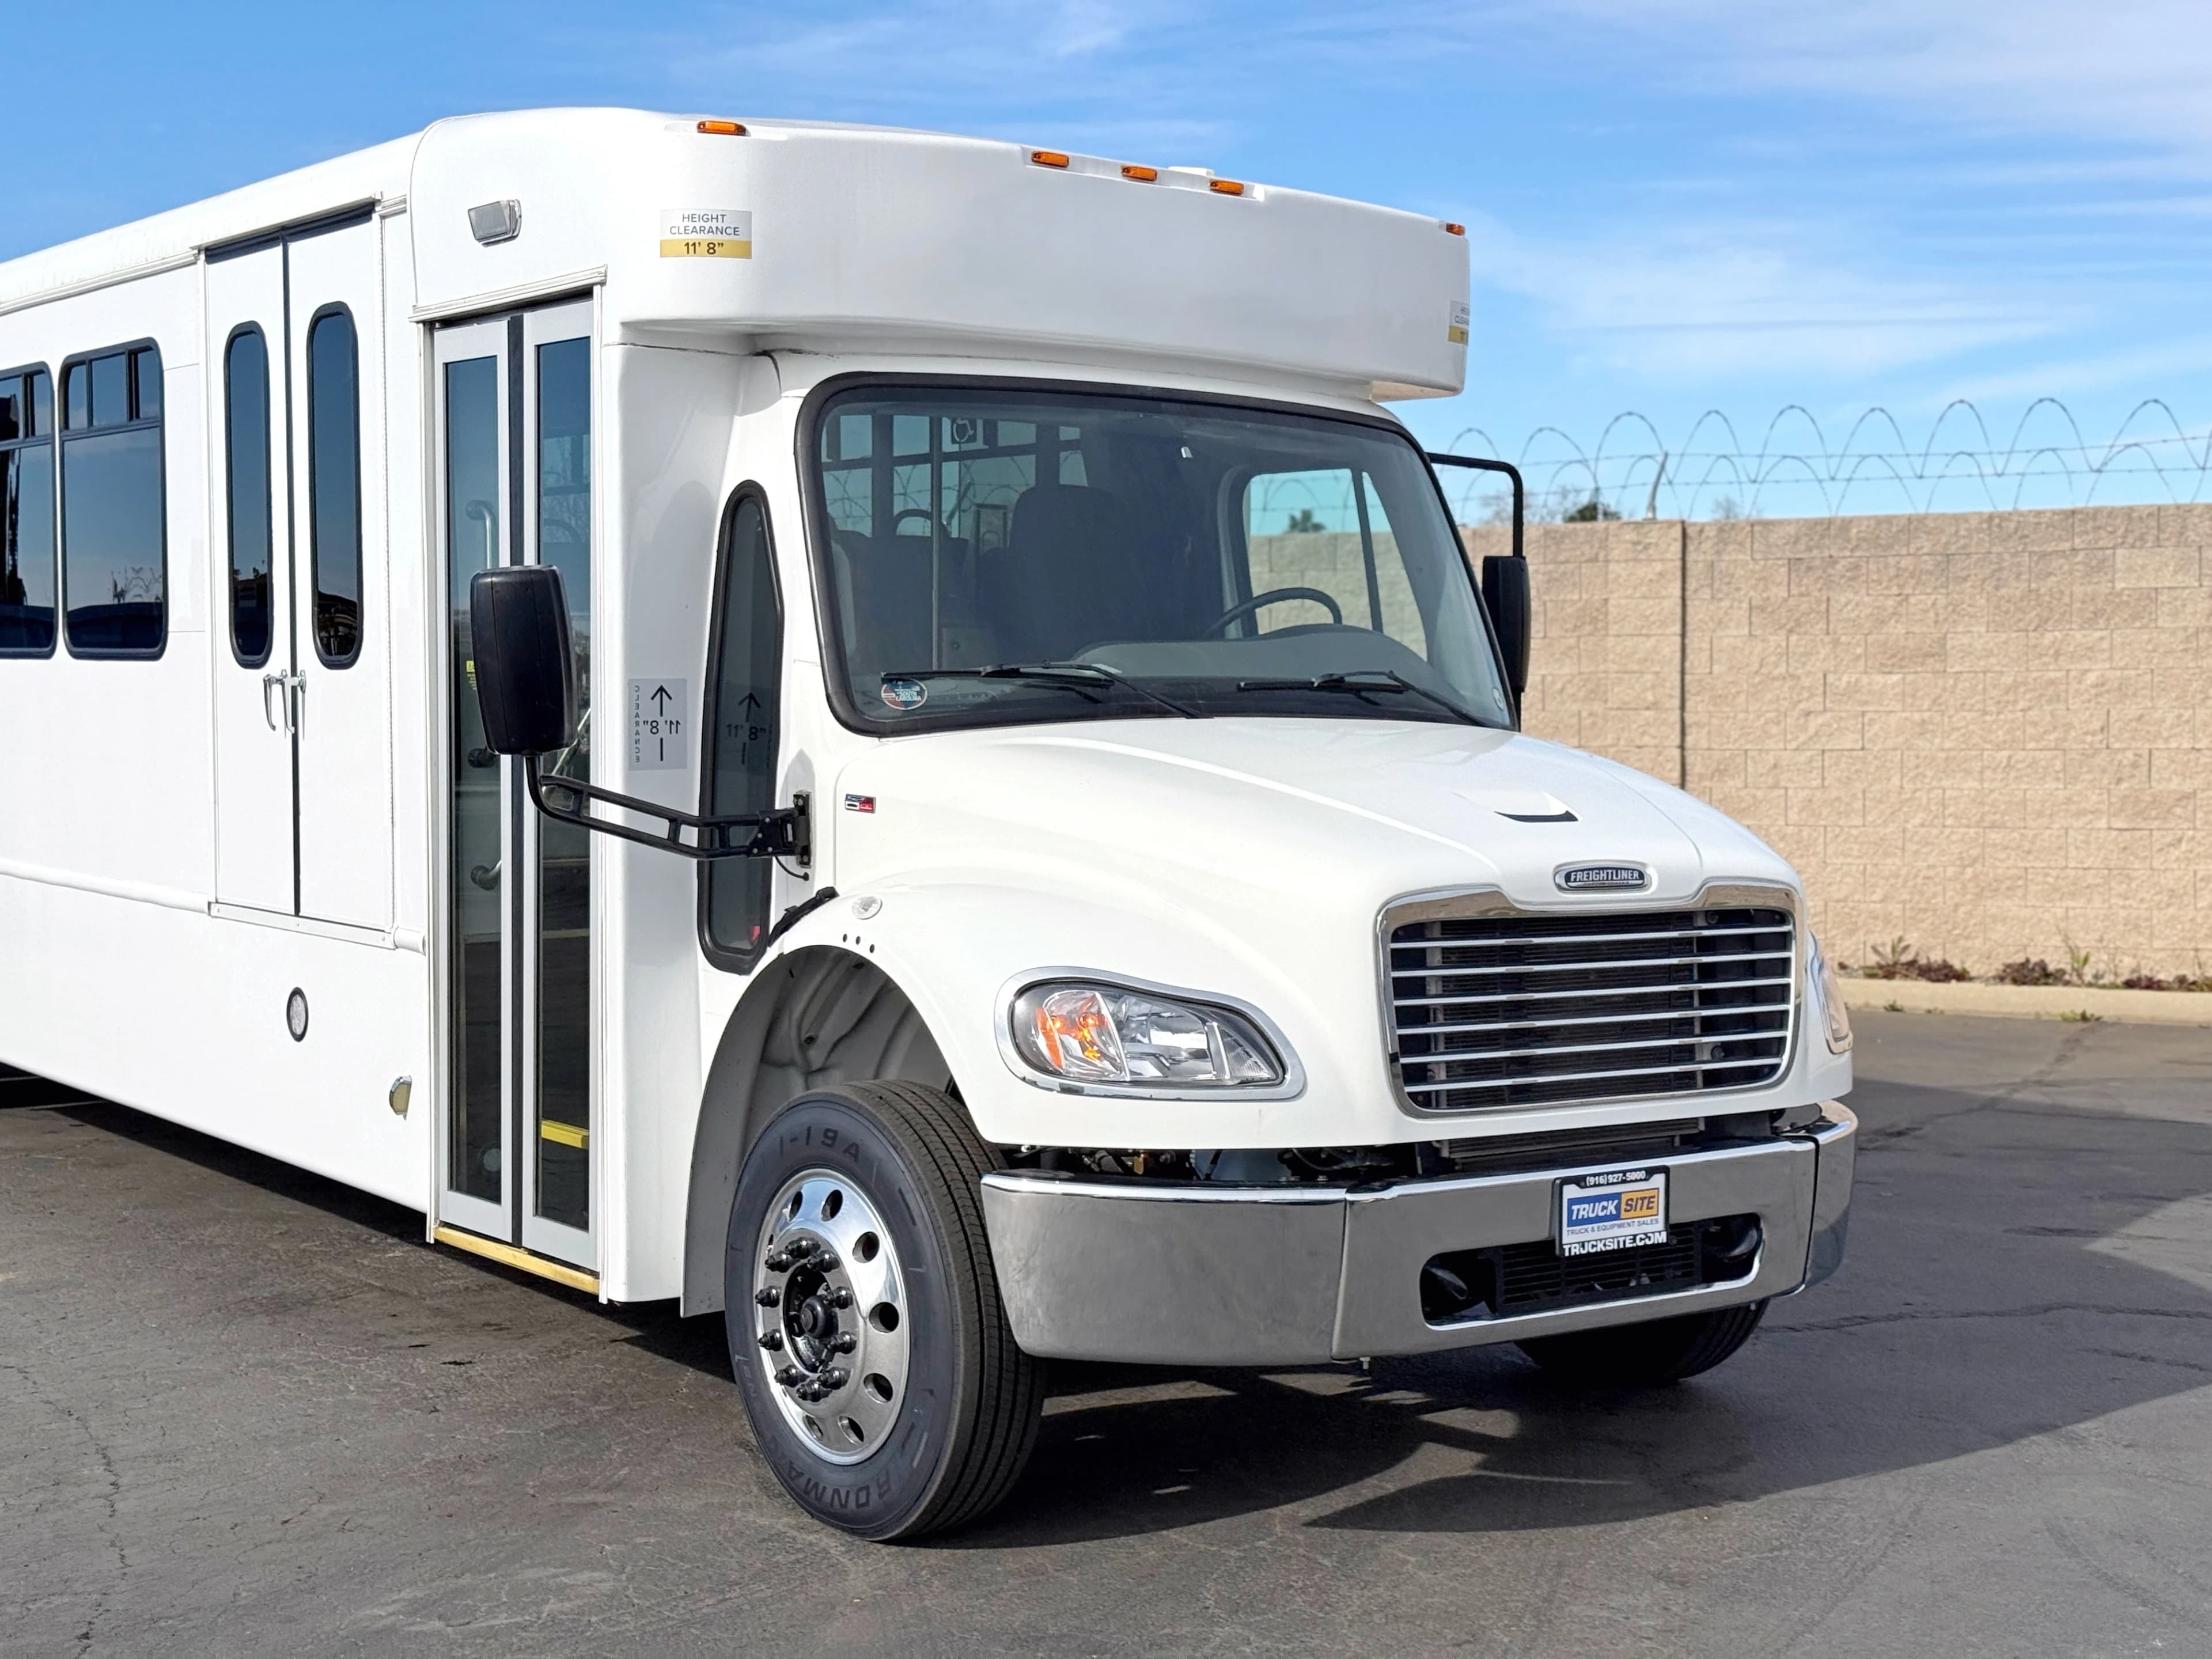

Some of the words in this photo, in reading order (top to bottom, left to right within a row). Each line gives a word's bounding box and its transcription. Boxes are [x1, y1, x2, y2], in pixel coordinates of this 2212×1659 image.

[682, 213, 727, 224] HEIGHT
[669, 225, 740, 236] CLEARANCE
[684, 241, 701, 255] 11'
[706, 242, 724, 255] 8"
[1570, 869, 1640, 882] FREIGHTLINER
[1571, 1199, 1619, 1220] TRUCK
[1623, 1195, 1656, 1213] SITE
[1566, 1227, 1589, 1237] TRUCK
[1597, 1221, 1635, 1232] EQUIPMENT
[1637, 1218, 1659, 1226] SALES
[1563, 1230, 1668, 1257] TRUCKSITE.COM
